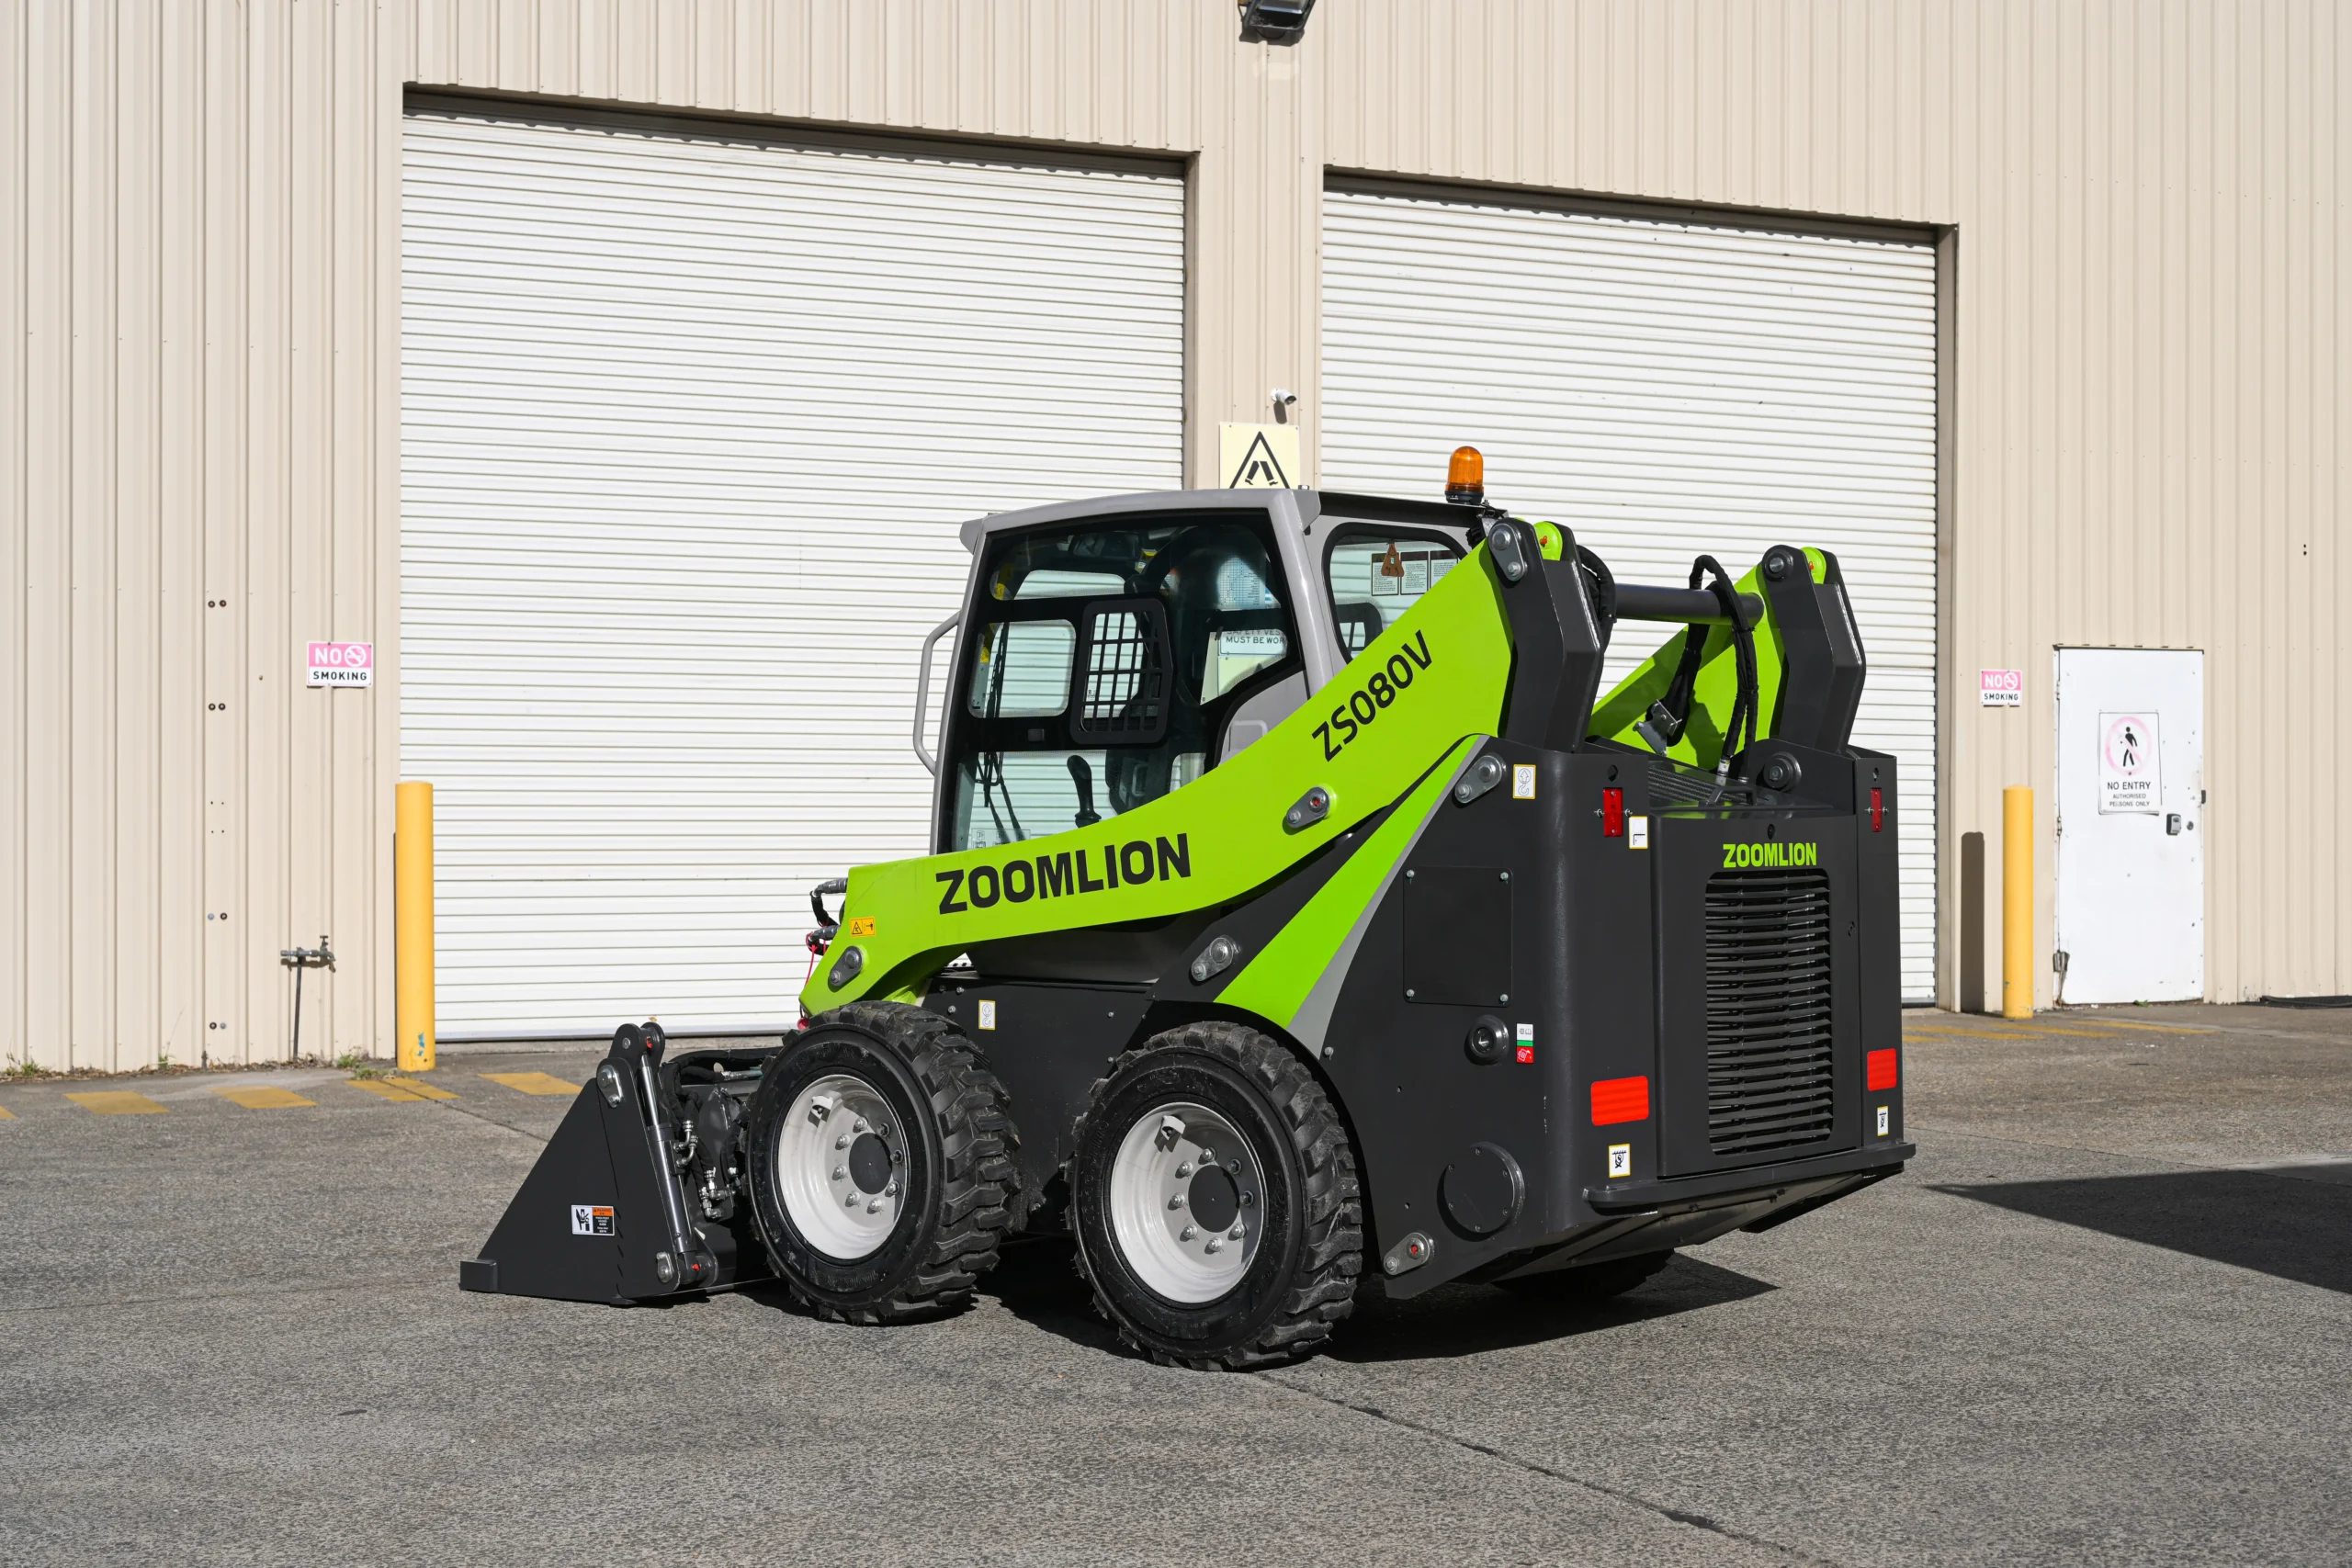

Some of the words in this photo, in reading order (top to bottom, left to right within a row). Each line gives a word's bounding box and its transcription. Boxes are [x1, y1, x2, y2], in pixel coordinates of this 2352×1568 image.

[1226, 636, 1251, 644] MUST
[1252, 636, 1265, 644] BE
[315, 648, 342, 665] NO
[313, 671, 367, 681] SMOKING
[1984, 674, 2003, 688] NO
[1311, 629, 1432, 762] ZS080V
[1984, 693, 2018, 701] SMOKING
[2107, 781, 2120, 790] NO
[2122, 781, 2151, 790] ENTRY
[1723, 842, 1817, 868] ZOOMLION
[935, 832, 1192, 915] ZOOMLION
